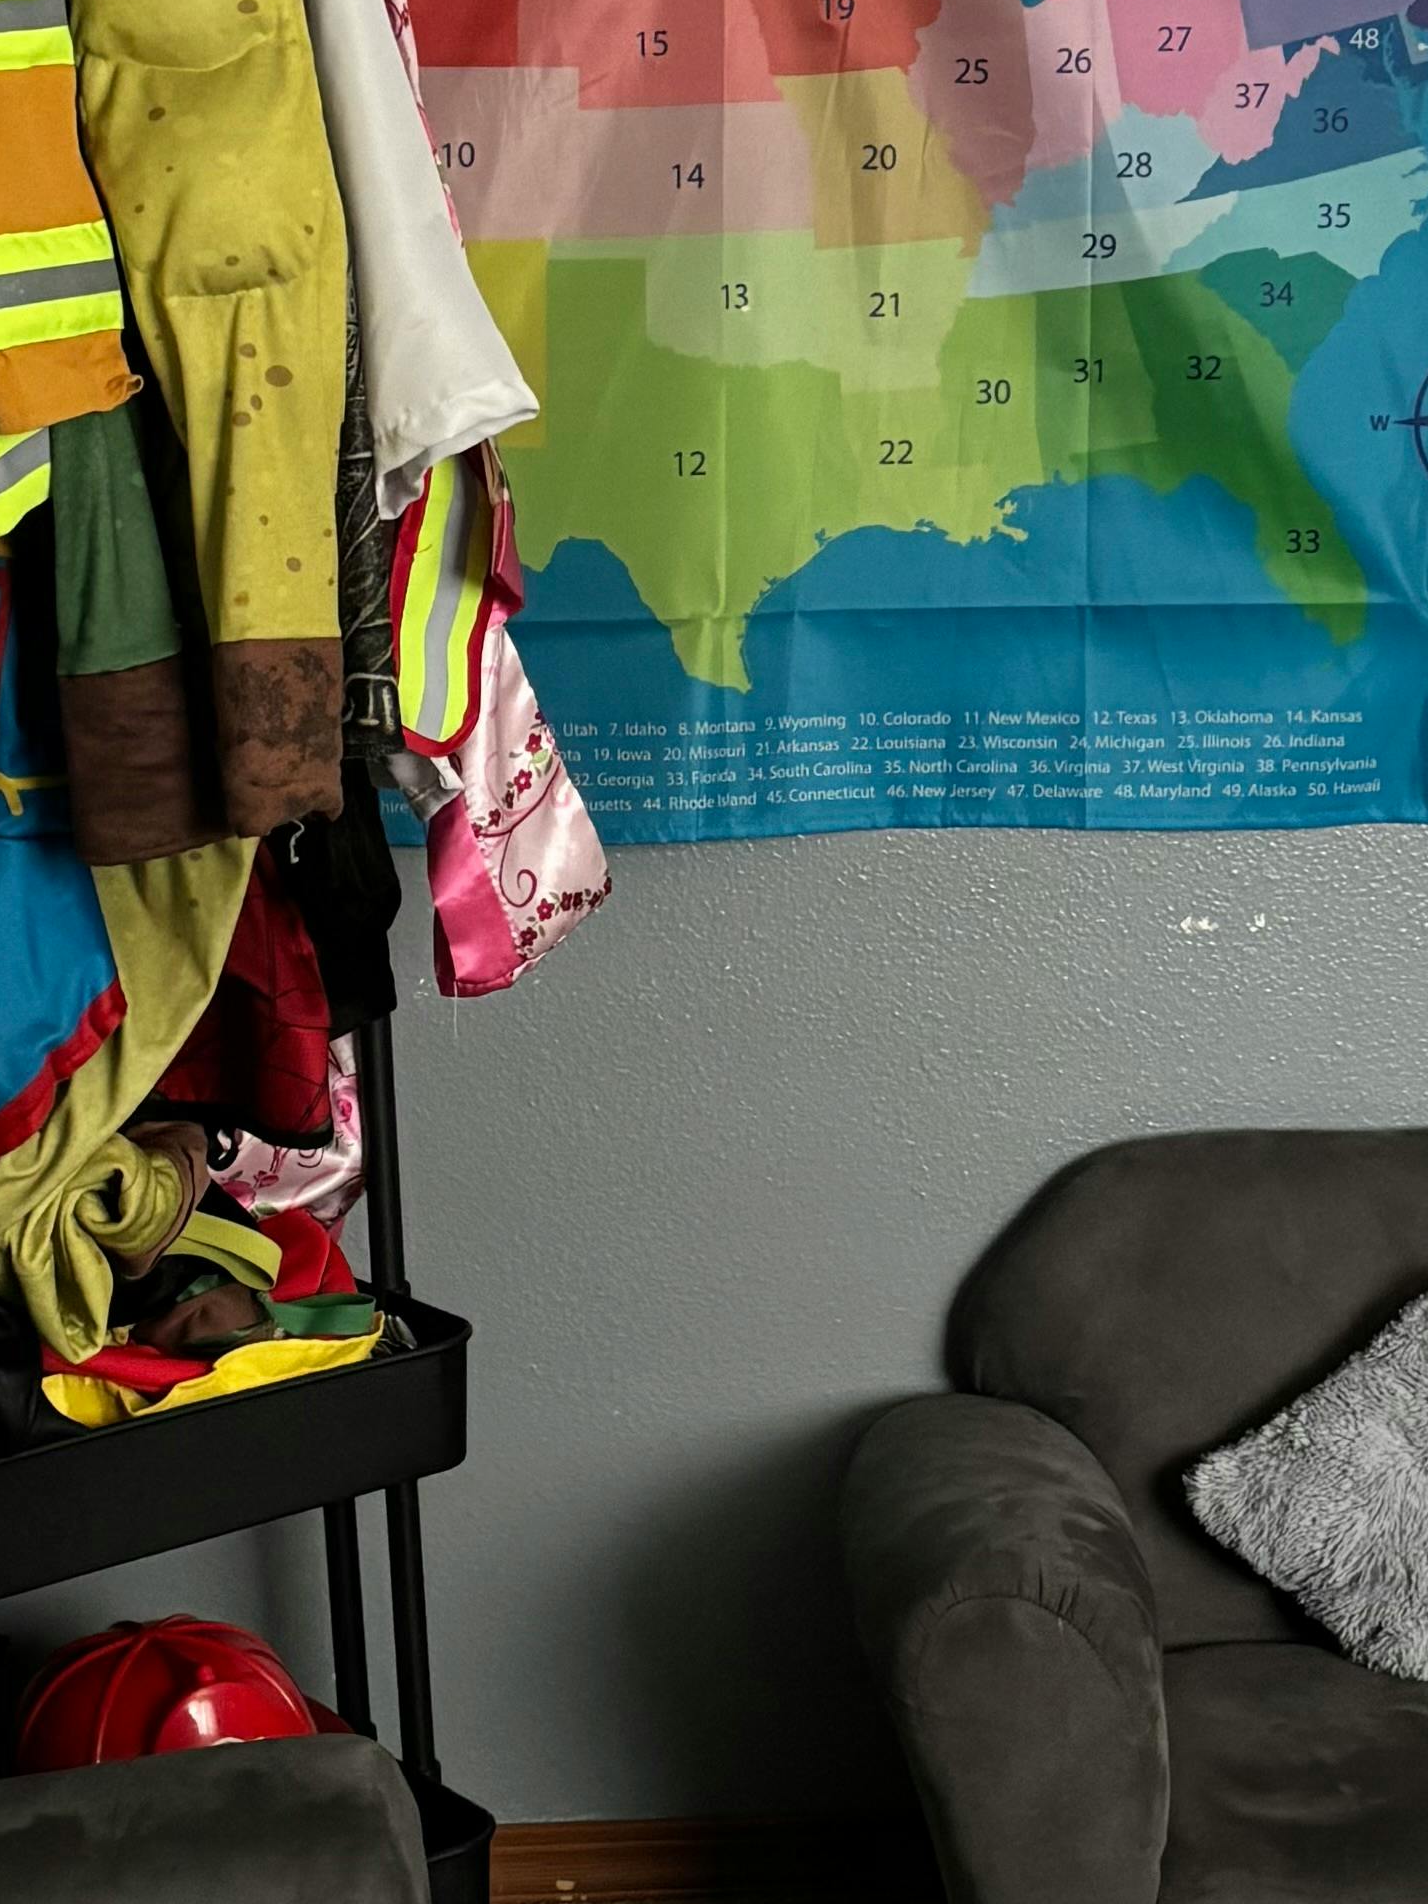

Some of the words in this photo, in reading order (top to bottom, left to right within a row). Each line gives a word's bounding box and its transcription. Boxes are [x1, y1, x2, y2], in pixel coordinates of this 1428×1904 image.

[637, 30, 668, 57] 15
[1158, 26, 1191, 52] 27
[1350, 28, 1379, 49] 48
[955, 58, 988, 84] 25
[1236, 83, 1269, 108] 37
[1314, 108, 1348, 133] 36
[862, 144, 896, 170] 20
[1117, 152, 1152, 178] 28
[673, 164, 704, 188] 14
[1318, 203, 1350, 228] 35
[675, 451, 706, 476] 12
[1286, 529, 1319, 553] 33
[563, 723, 598, 736] Utah
[625, 722, 667, 736] Idaho
[695, 721, 755, 735] Montana
[779, 715, 846, 732] Wyoming
[883, 712, 951, 726] Colorado
[988, 712, 1023, 724] New
[1026, 711, 1080, 725] Mexico
[1116, 711, 1157, 724] Texas
[1195, 710, 1273, 724] Oklahoma
[1311, 709, 1362, 723] Kansas
[777, 739, 839, 753] Arkansas
[876, 737, 946, 750] Louisiana
[983, 736, 1057, 749] Wisconsin
[1095, 735, 1165, 752] Michigan
[1202, 734, 1251, 748] Illinois
[1288, 735, 1345, 747] Indiana
[597, 773, 654, 789] Georgia
[909, 760, 952, 773] North
[956, 759, 1018, 773] Carolina
[1147, 760, 1183, 773] West
[1188, 759, 1245, 776] Virginia
[1282, 758, 1377, 774] Pennsylvania
[789, 787, 875, 802] Connecticut
[1033, 784, 1103, 798] Delaware
[1140, 783, 1211, 801] Maryland
[1248, 783, 1297, 796] Alaska
